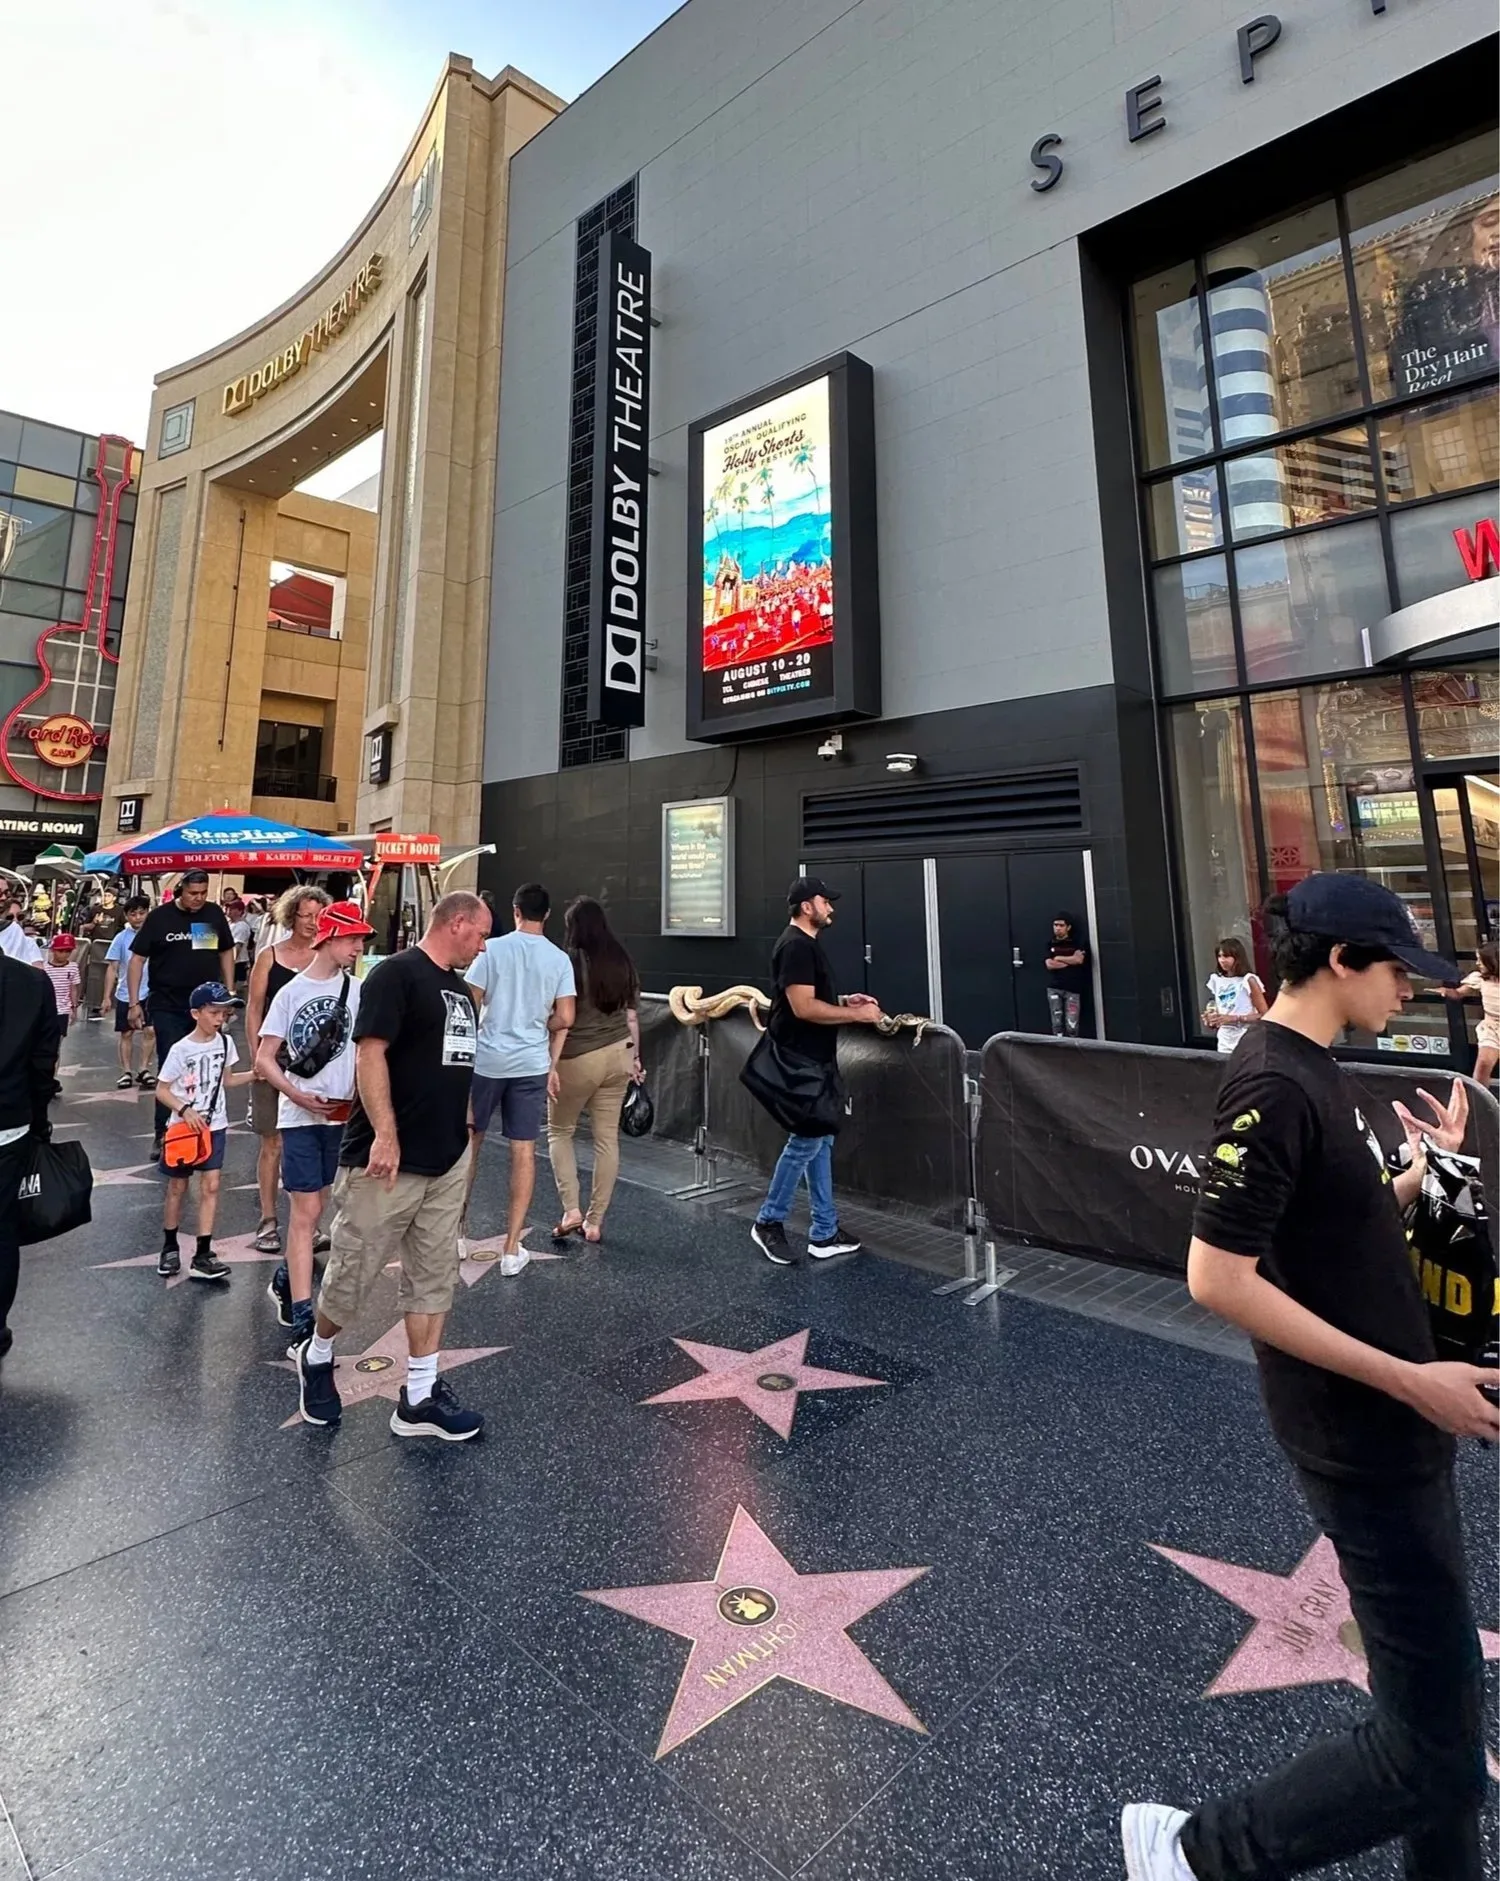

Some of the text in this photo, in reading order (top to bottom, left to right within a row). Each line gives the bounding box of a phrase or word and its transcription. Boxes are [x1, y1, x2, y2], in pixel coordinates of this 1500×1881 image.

[1031, 0, 1387, 193] SEP
[249, 251, 383, 398] DOLBY THEATRE
[1401, 346, 1437, 368] The
[1405, 343, 1488, 383] Dry Hair
[724, 413, 807, 454] OSCAR QUALIFYING
[741, 418, 773, 437] ANNUAL
[611, 262, 644, 620] DOLBY THEATRE
[723, 662, 767, 682] AUGUST
[772, 658, 785, 671] 10
[796, 652, 811, 666] 20
[10, 720, 67, 743] Hard
[41, 822, 84, 835] NOW!
[129, 853, 229, 867] TICKETS BOLETOS
[266, 853, 303, 861] KARTEN
[376, 842, 440, 855] TICKET BOOTH
[295, 1001, 320, 1025] WEST
[1277, 1578, 1341, 1654] JIM GRAY
